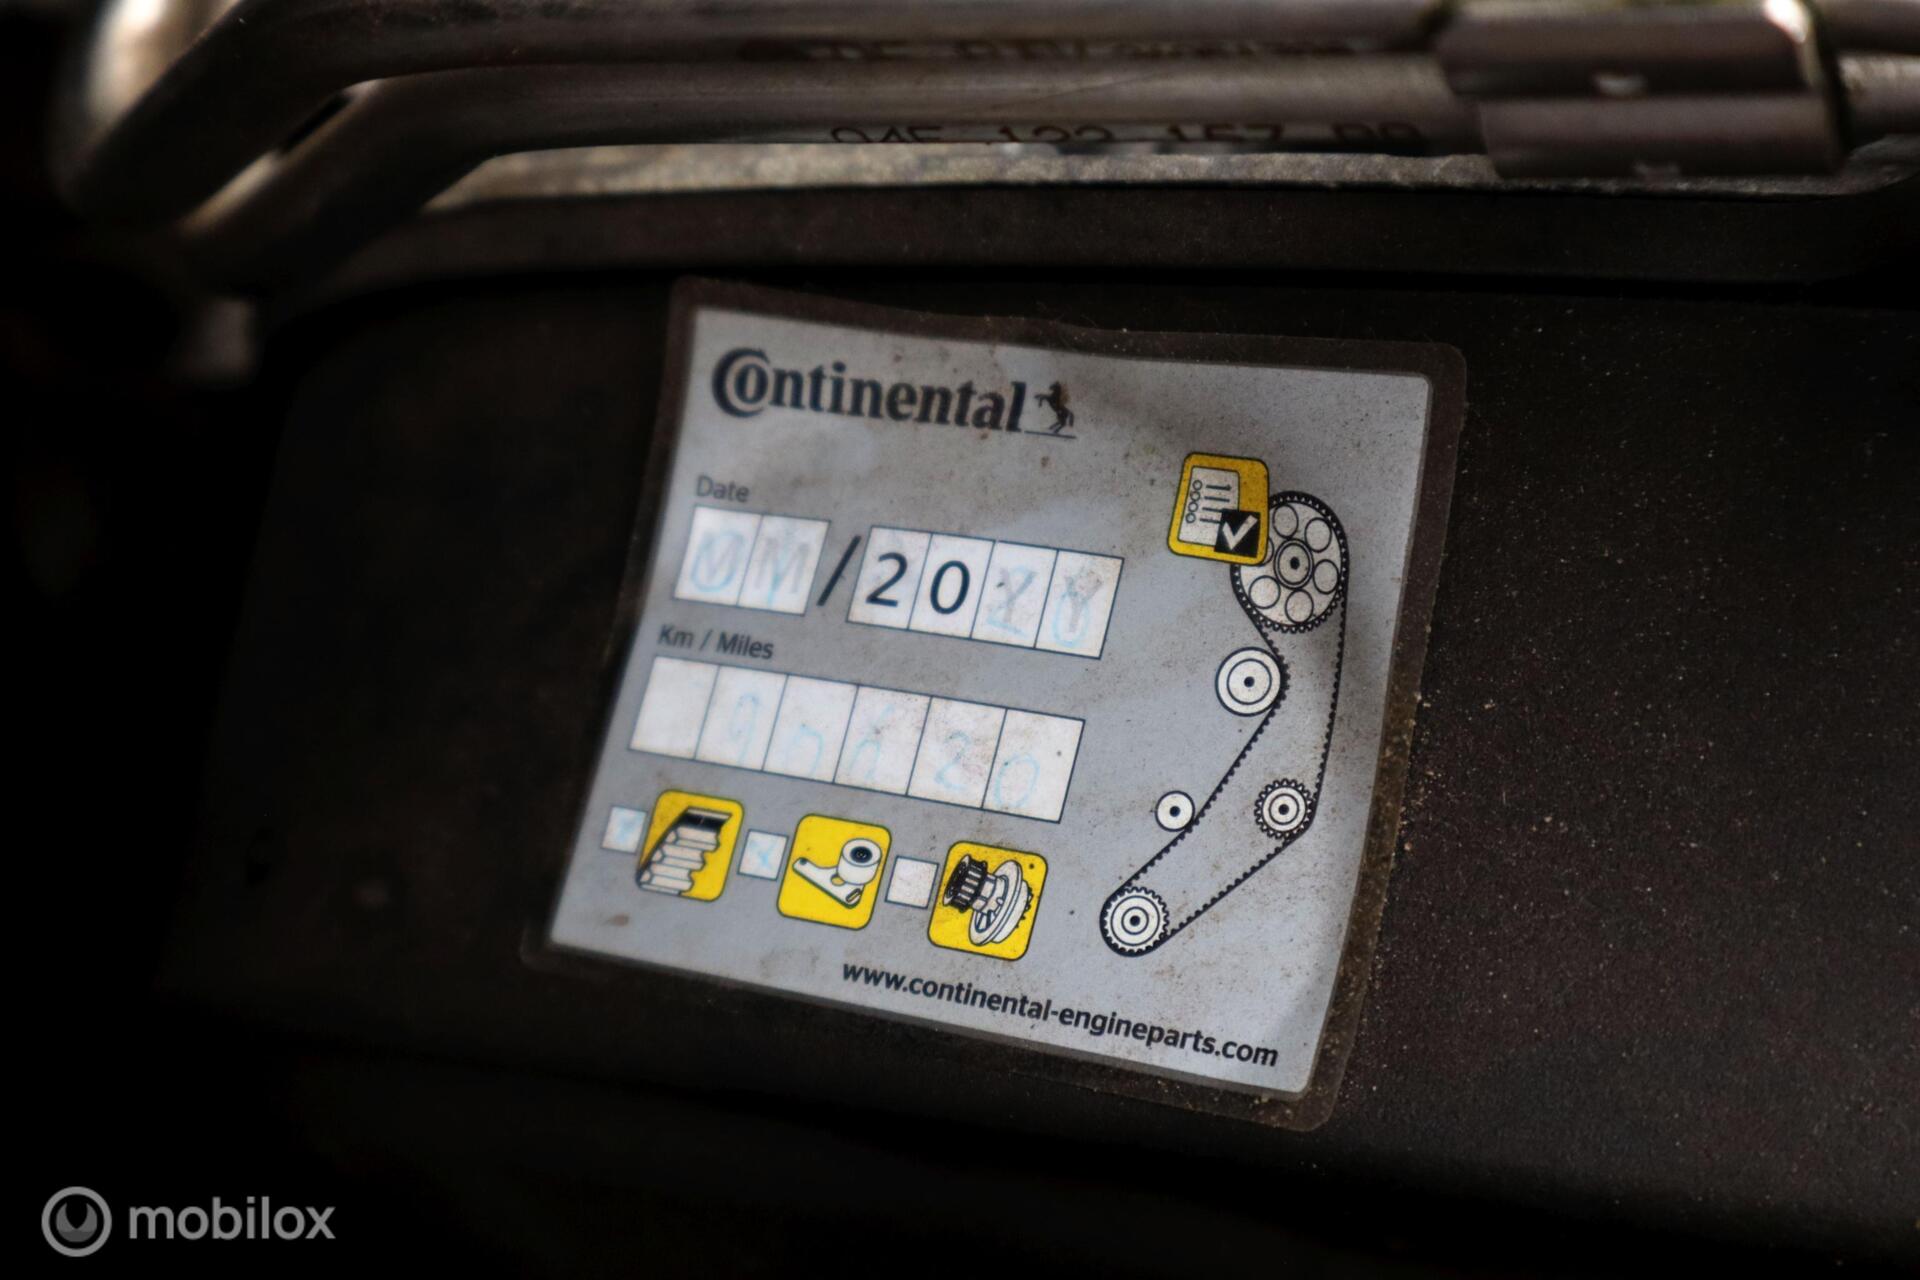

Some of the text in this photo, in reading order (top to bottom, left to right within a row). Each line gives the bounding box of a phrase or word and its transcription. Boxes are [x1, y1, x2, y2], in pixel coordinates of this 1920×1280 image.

[711, 346, 1027, 433] Continental
[695, 475, 750, 503] Date
[658, 625, 695, 648] Km
[716, 632, 774, 660] Miles
[842, 962, 1279, 1068] www.continental-engineparts.com
